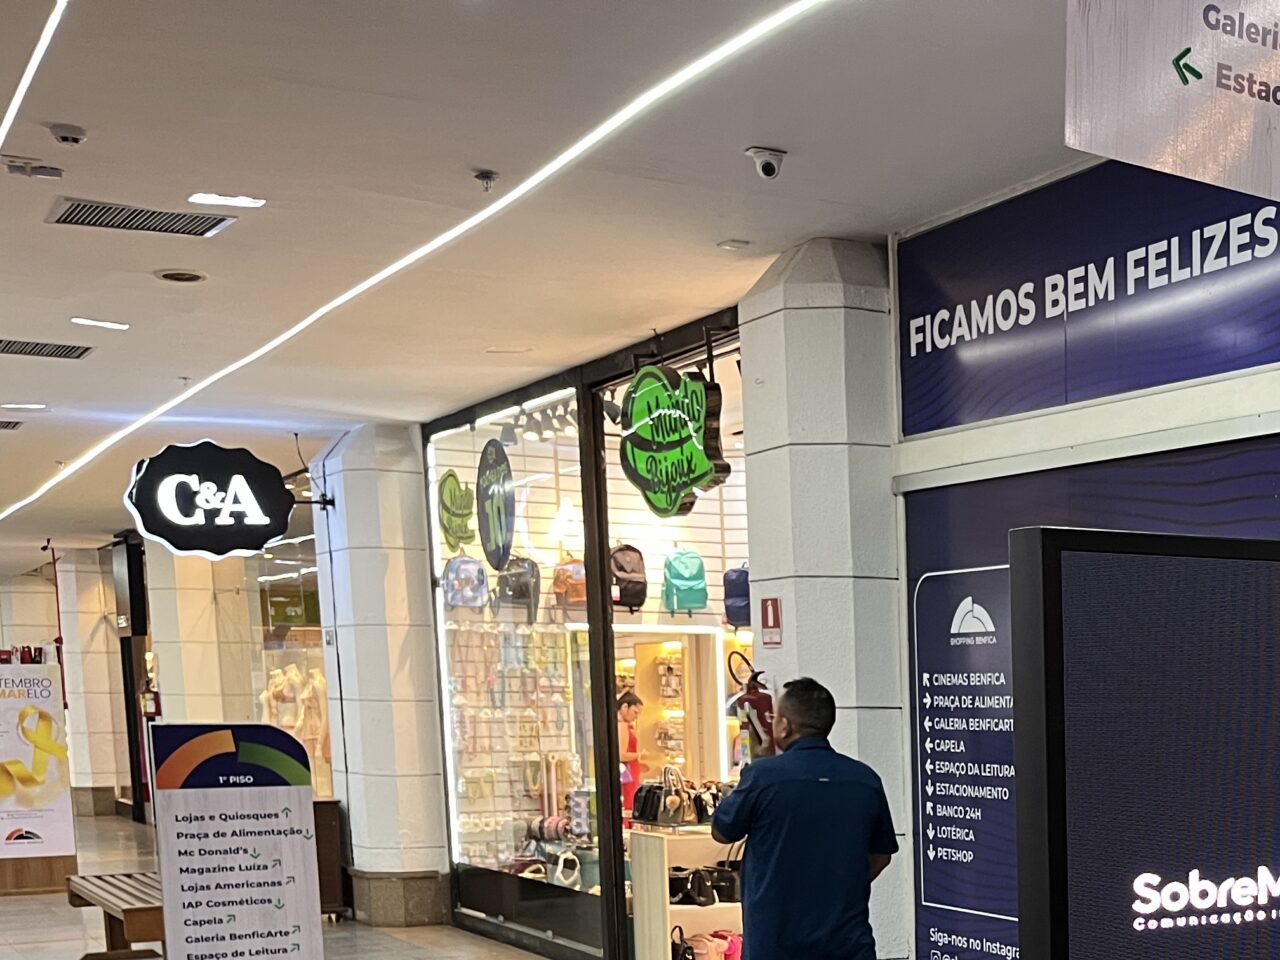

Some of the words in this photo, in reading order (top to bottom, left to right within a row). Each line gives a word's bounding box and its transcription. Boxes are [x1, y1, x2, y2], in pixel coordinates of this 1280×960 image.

[909, 282, 1036, 358] FICAMOS
[1044, 256, 1116, 320] BEM
[1126, 205, 1278, 296] FELIZES
[157, 474, 271, 526] C&A
[976, 636, 997, 644] BENFICA
[933, 673, 968, 685] CINEMAS
[970, 673, 1006, 685] BENFICA
[933, 696, 960, 711] PRAÇA
[961, 696, 973, 708] DE
[934, 718, 967, 730] GALERIA
[969, 719, 1014, 731] BENFICART
[934, 740, 965, 752] CAPELA
[935, 761, 966, 777] ESPAÇO
[968, 763, 980, 775] DA
[981, 764, 1015, 777] LEITURA
[229, 775, 253, 784] PISO
[936, 783, 1009, 800] ESTACIONAMENTO
[175, 814, 205, 823] Lojas
[219, 812, 279, 822] Quiosques
[936, 805, 964, 818] BANCO
[965, 807, 981, 820] 24H
[176, 831, 209, 840] Praça
[213, 830, 227, 838] de
[231, 828, 302, 837] Alimentação
[937, 825, 975, 841] LOTÉRICA
[178, 849, 194, 857] Mc
[199, 847, 248, 856] Donald's
[937, 848, 974, 862] PETSHOP
[179, 865, 235, 875] Magazine
[181, 884, 211, 893] Lojas
[215, 879, 282, 890] Americanas
[182, 902, 202, 910] IAP
[206, 897, 272, 908] Cosméticos
[184, 917, 223, 927] Capela
[185, 934, 226, 944] Galeria
[230, 930, 290, 941] BenficArte
[929, 927, 968, 948] Siga-nos
[969, 939, 981, 950] no
[231, 950, 245, 958] de
[249, 947, 288, 956] Leitura
